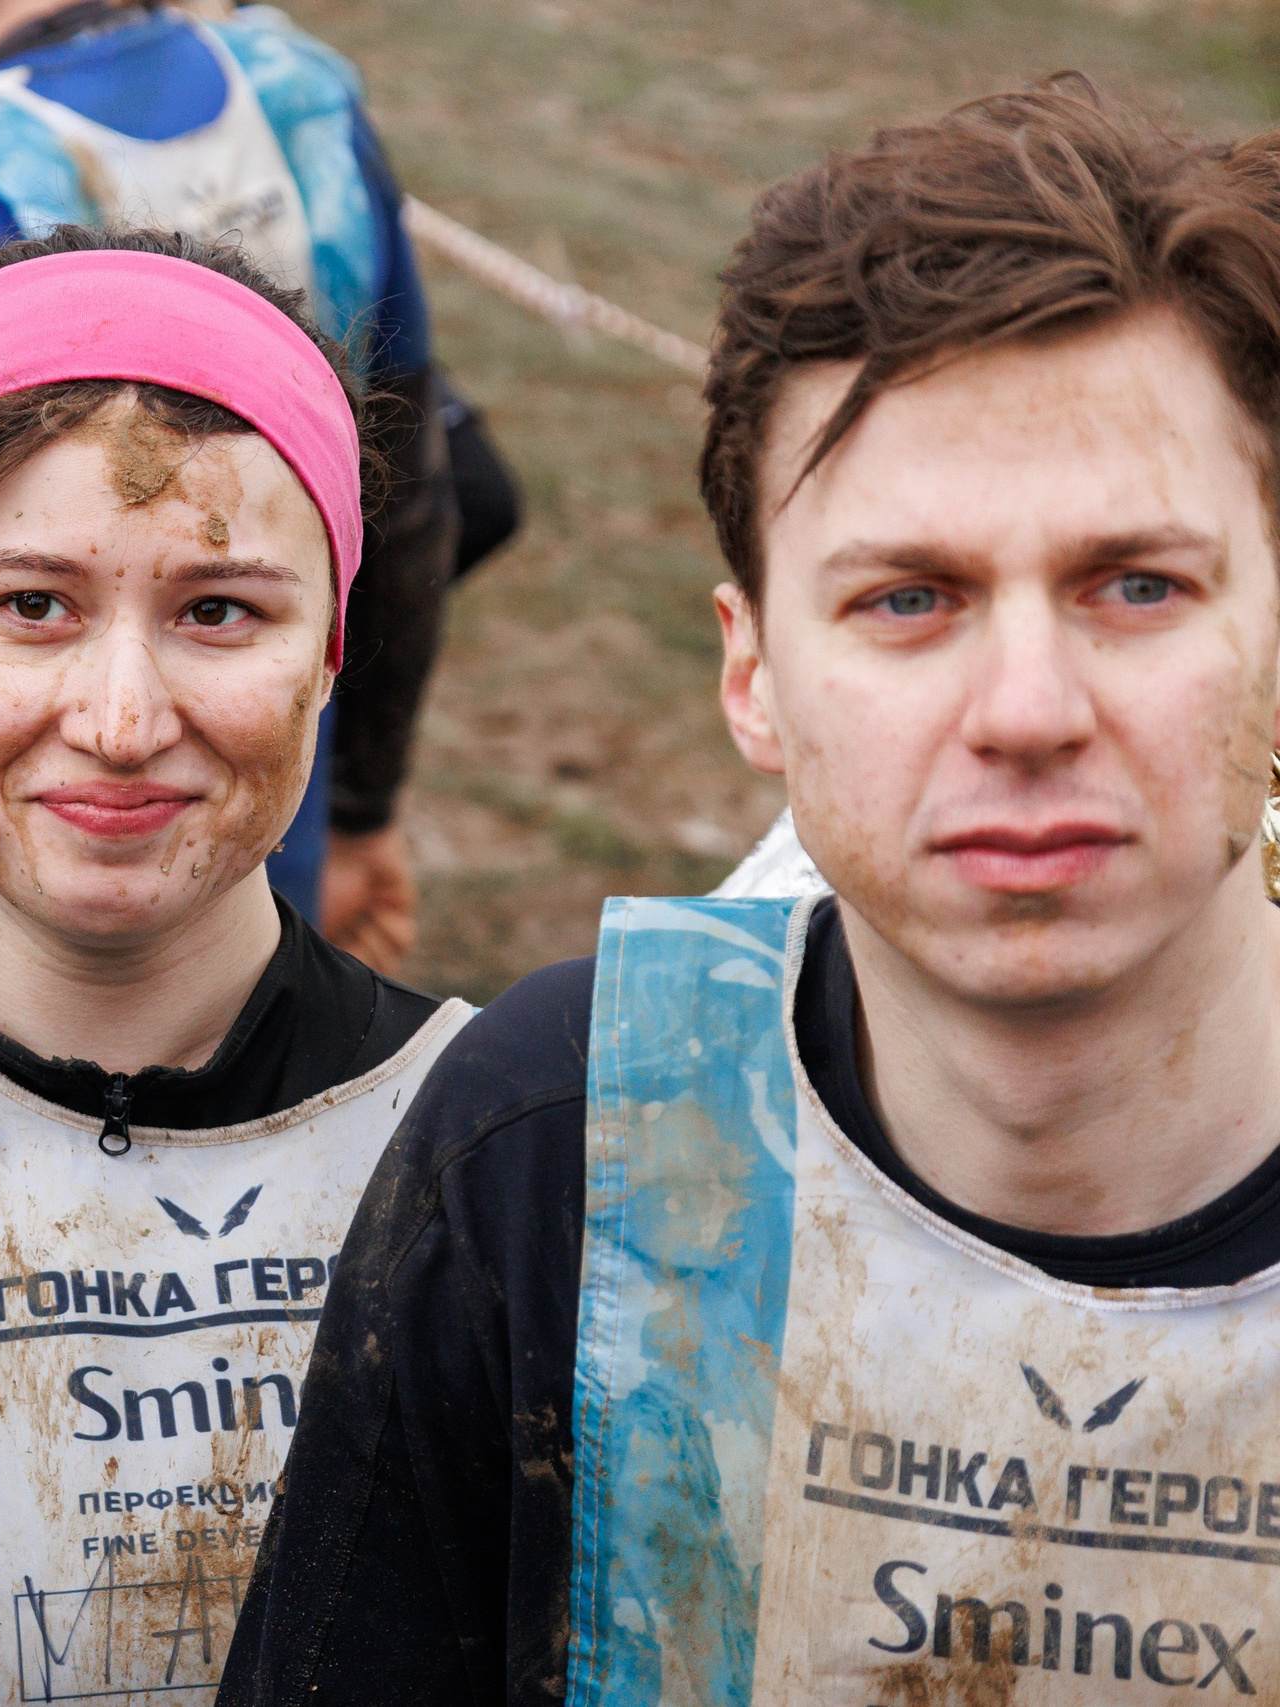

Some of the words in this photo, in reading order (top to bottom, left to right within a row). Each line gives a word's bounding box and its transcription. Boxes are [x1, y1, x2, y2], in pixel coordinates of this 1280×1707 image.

[214, 1254, 340, 1305] ГЕР
[68, 1357, 306, 1442] Smin
[78, 1481, 278, 1516] ПЕРФЕКЦИ
[807, 1420, 1039, 1516] ГОНКА
[83, 1532, 159, 1559] FINE
[868, 1560, 1257, 1696] Sminex
